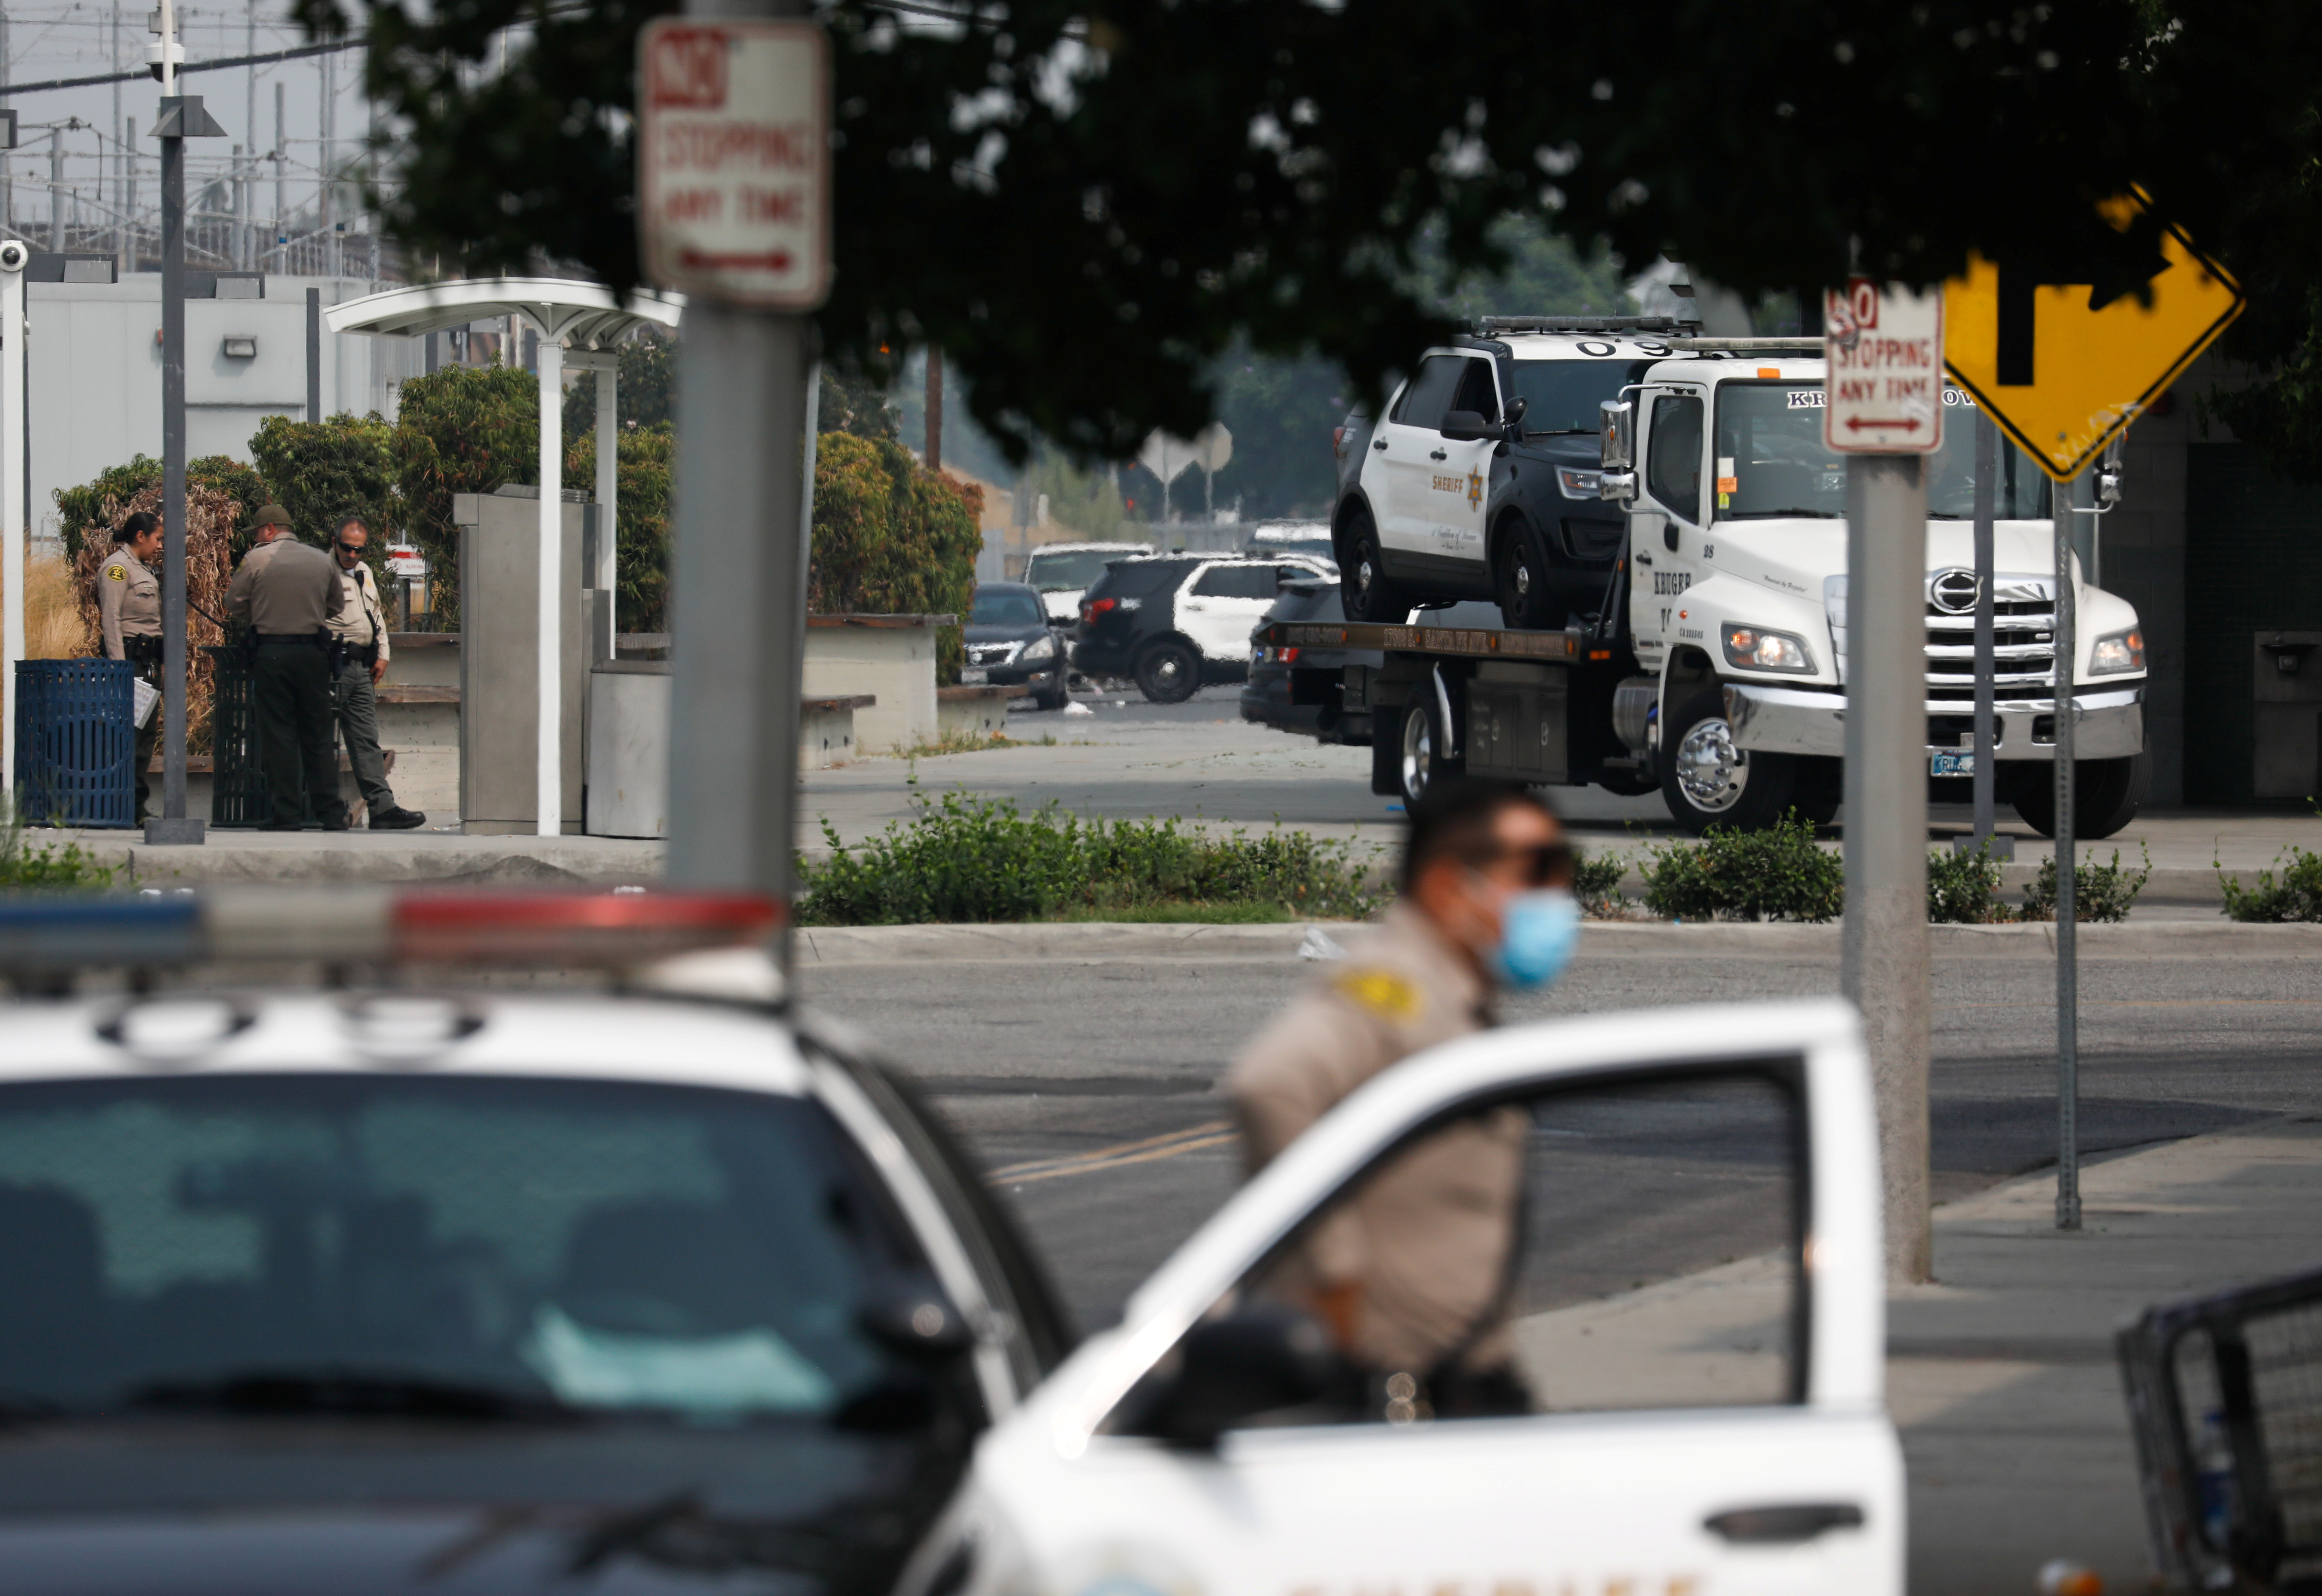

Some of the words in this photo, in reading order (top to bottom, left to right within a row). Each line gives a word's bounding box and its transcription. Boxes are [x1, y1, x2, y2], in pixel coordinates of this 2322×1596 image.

[1838, 379, 1876, 402] ANY
[1433, 475, 1463, 494] SHERIFF
[1654, 571, 1691, 596] KRUGER
